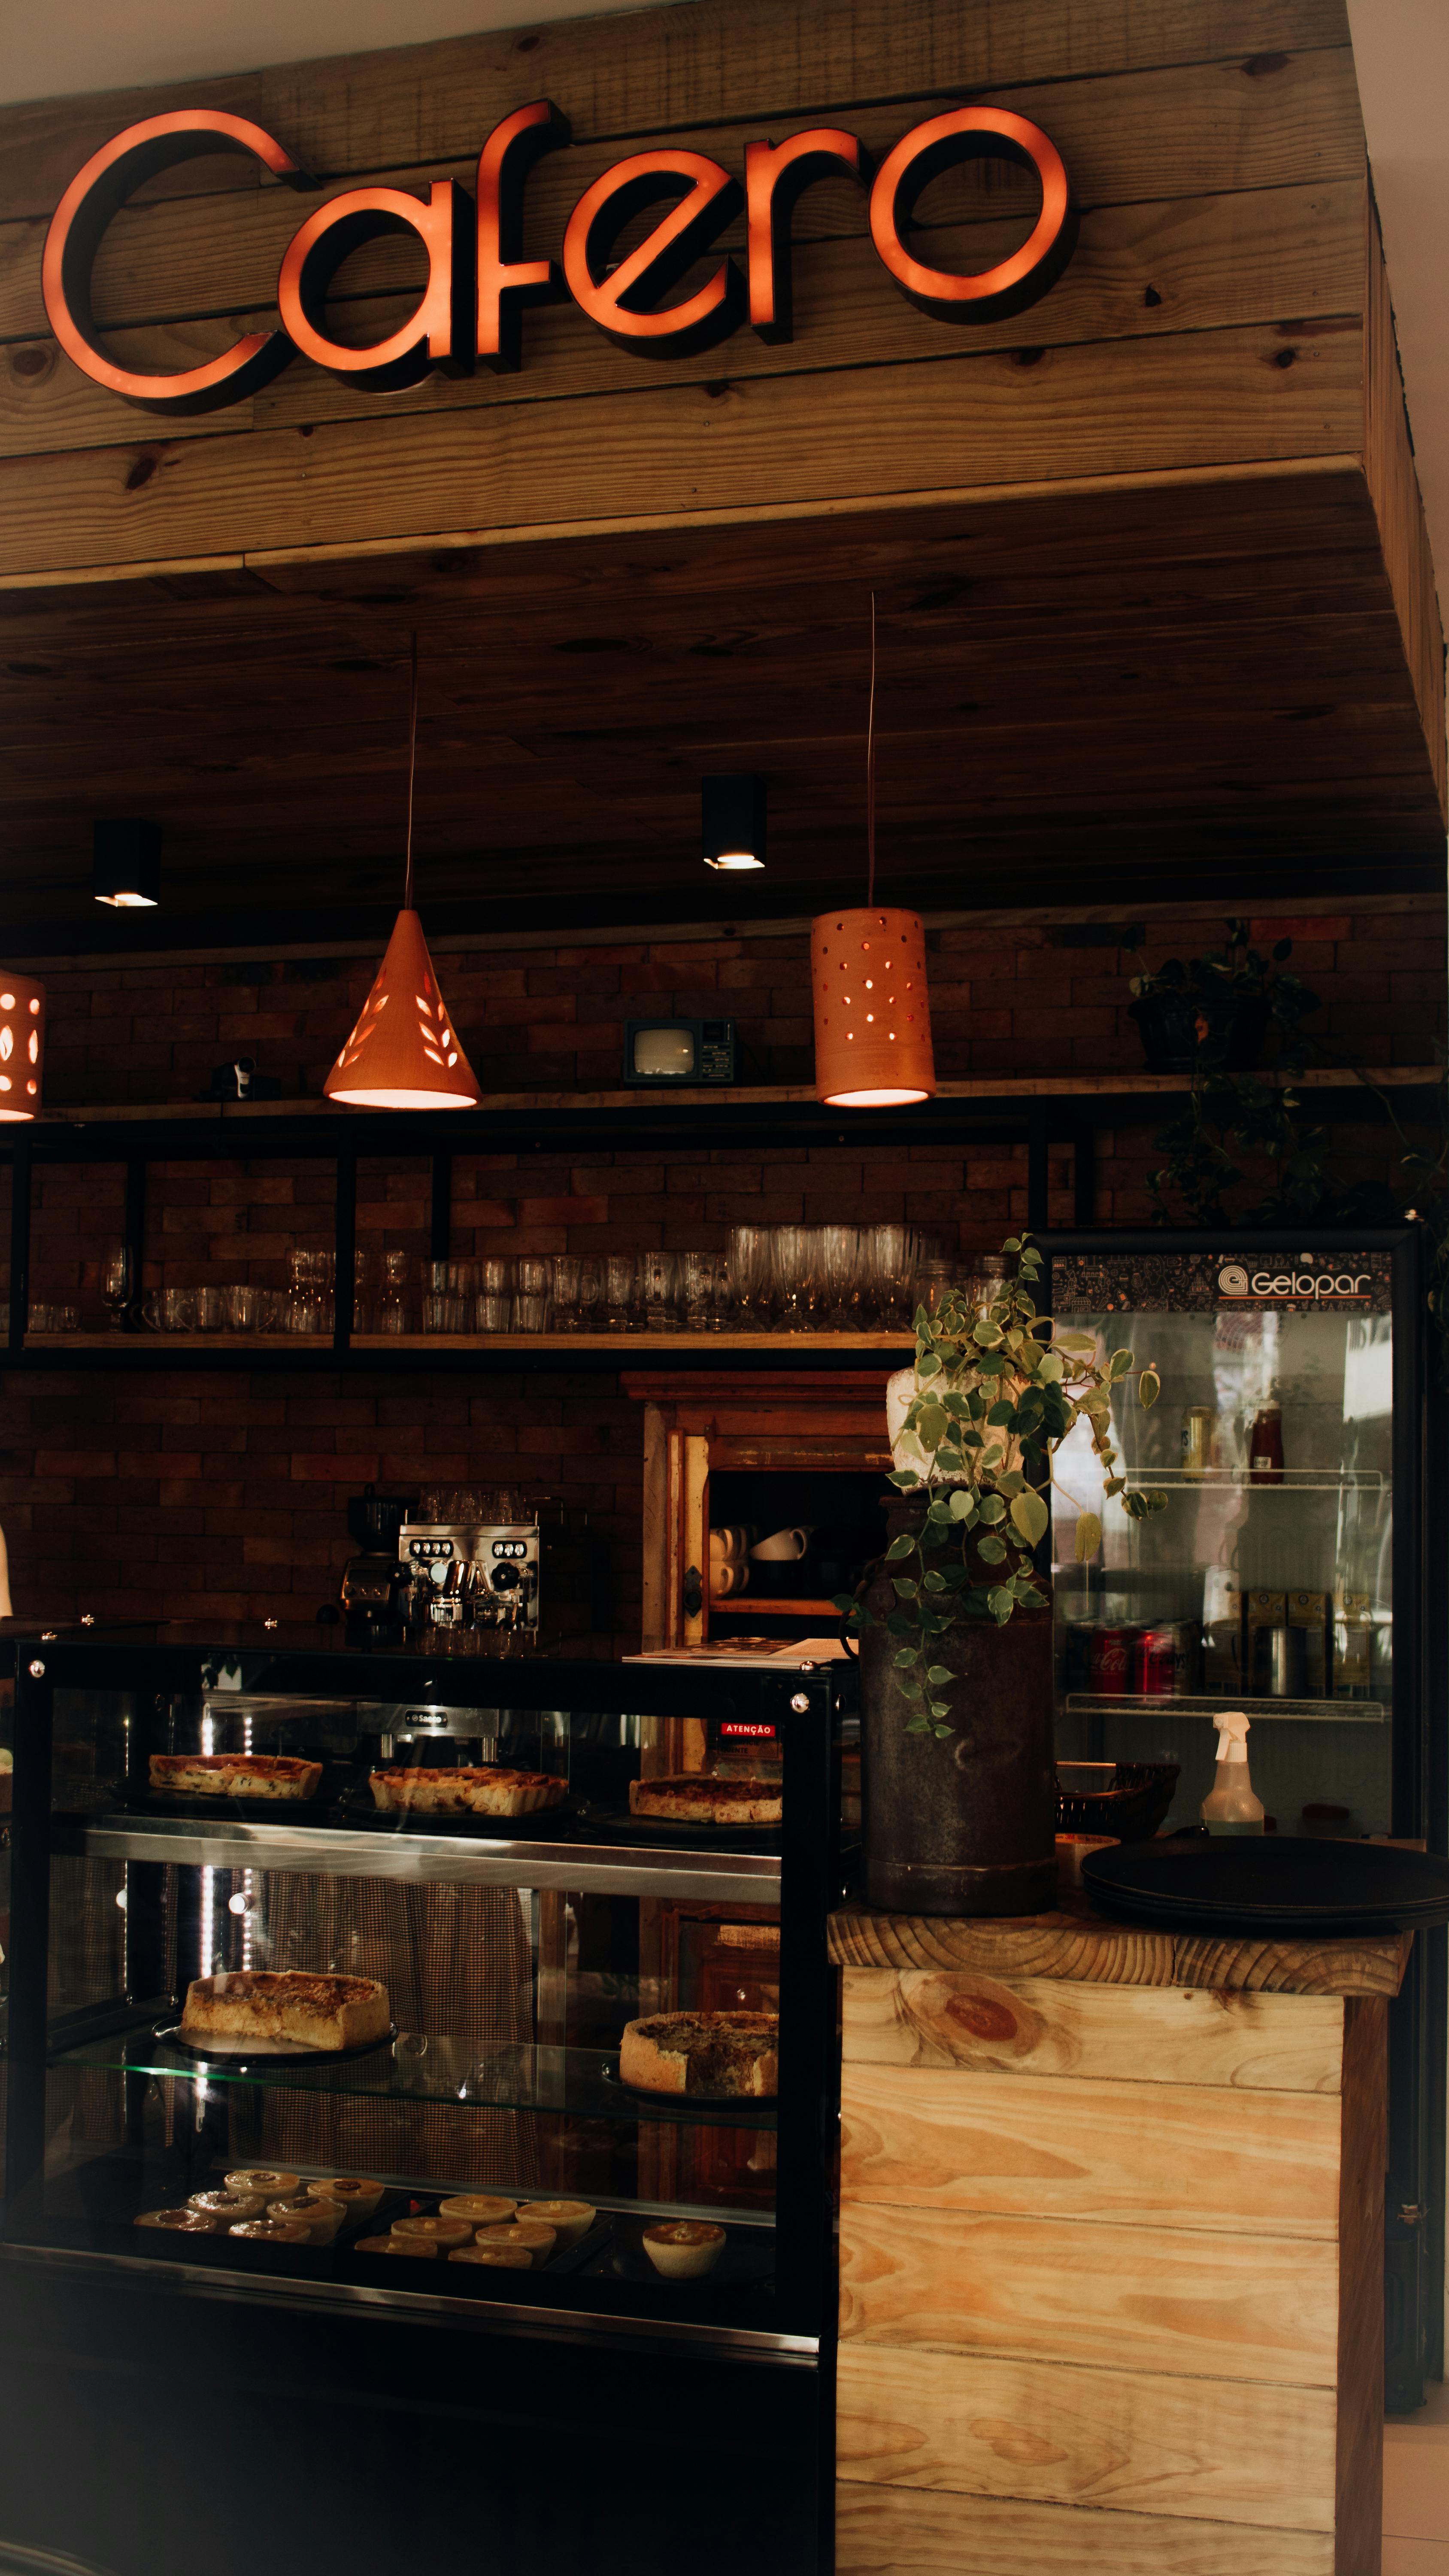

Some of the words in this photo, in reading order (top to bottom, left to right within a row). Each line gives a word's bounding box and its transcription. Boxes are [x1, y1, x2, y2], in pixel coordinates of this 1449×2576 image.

[41, 100, 1070, 403] Cafero
[1252, 1271, 1371, 1300] Gelopar
[726, 1725, 771, 1735] ATENÇÃO
